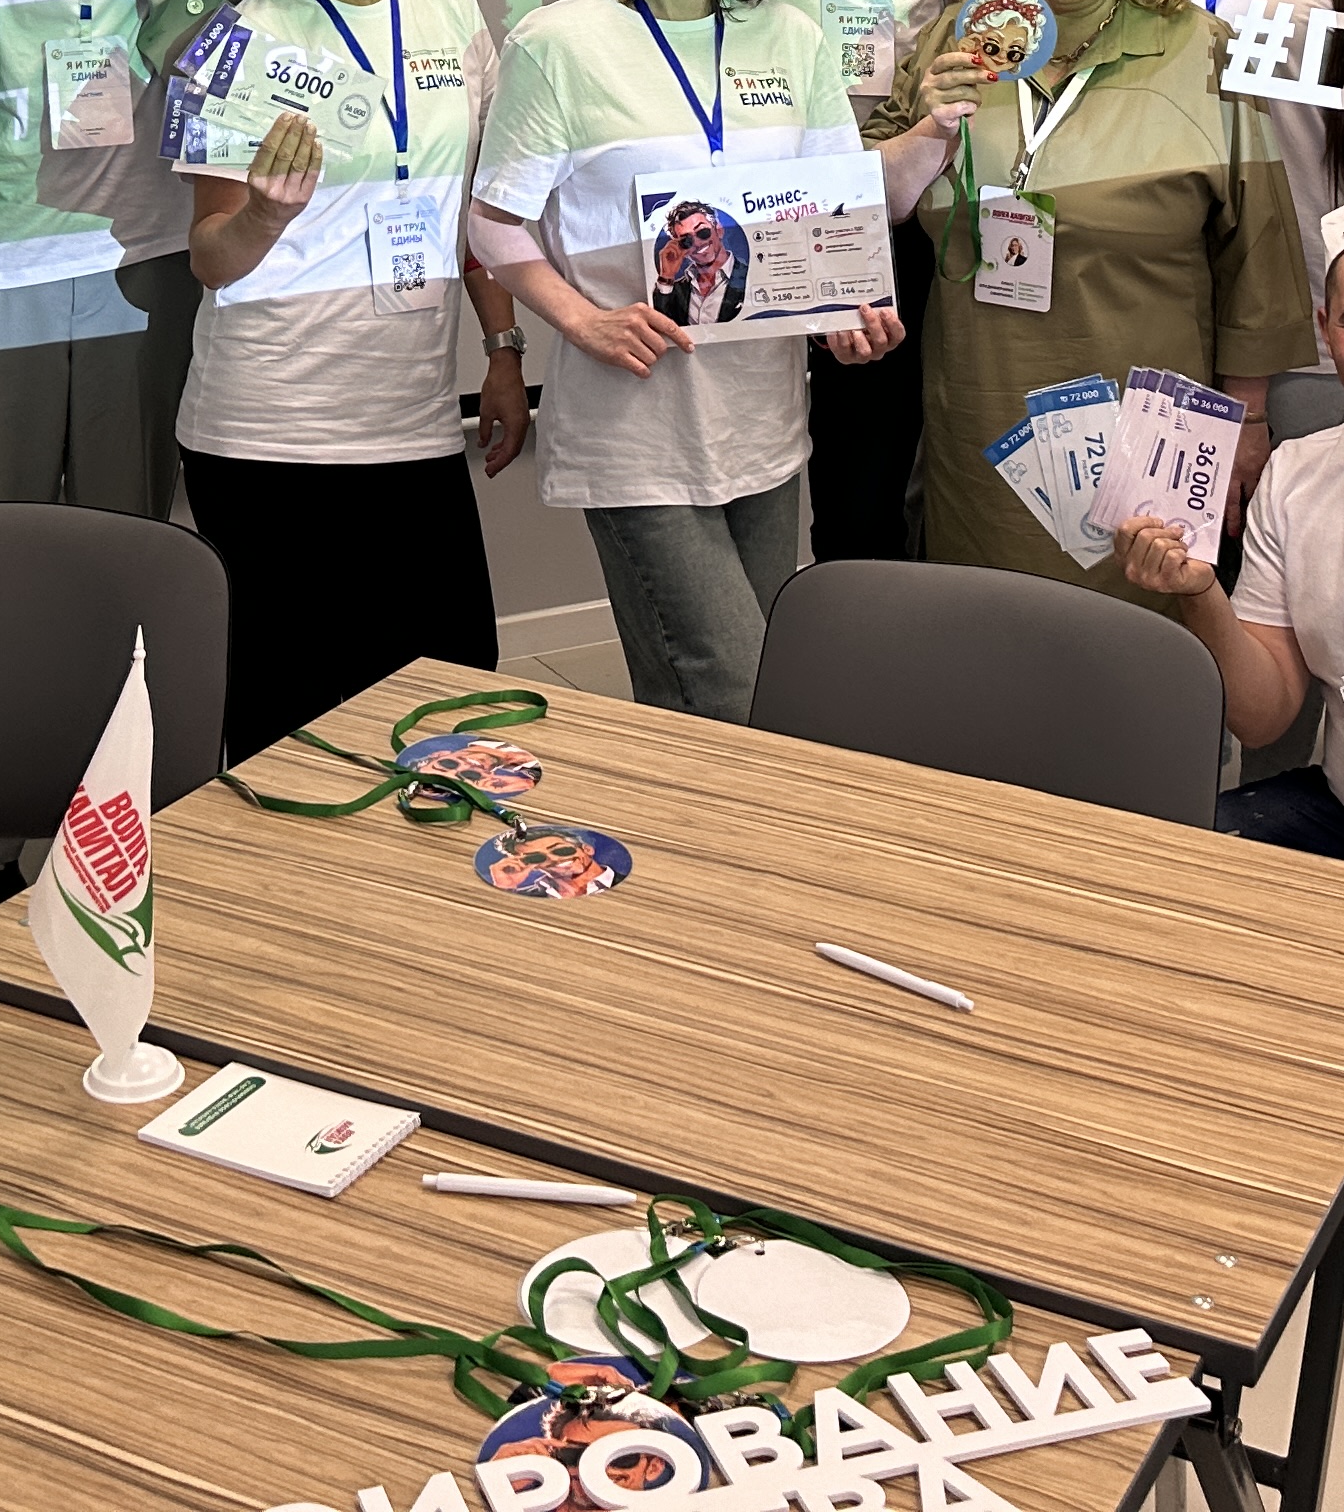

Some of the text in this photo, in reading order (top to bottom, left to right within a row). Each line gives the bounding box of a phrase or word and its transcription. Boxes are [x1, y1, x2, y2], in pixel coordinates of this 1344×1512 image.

[838, 16, 879, 26] Я И ТРУД
[200, 37, 213, 51] 36
[209, 22, 225, 40] 000
[842, 25, 875, 37] ЕДИНЫ
[66, 58, 112, 70] Я И ТРУД
[221, 58, 234, 73] 36
[228, 41, 242, 60] 000
[409, 57, 461, 73] Я И ТРУД
[71, 70, 108, 82] ЕДИНЫ
[265, 60, 293, 85] 36
[294, 71, 335, 100] 000
[414, 73, 466, 92] ЕДИНЫ
[733, 75, 791, 92] Я И ТРУД
[739, 92, 794, 108] ЕДИНЫ
[171, 115, 181, 132] 36
[742, 188, 810, 215] Бизнес-
[775, 201, 819, 223] акула
[387, 222, 427, 235] Я И ТРУД
[391, 233, 424, 247] ЕДИНЫ
[1069, 392, 1082, 402] 72
[1082, 389, 1100, 400] 000
[1200, 400, 1212, 411] 36
[1212, 402, 1229, 415] 000
[1009, 432, 1022, 446] 72
[1019, 421, 1034, 437] 000
[1084, 432, 1107, 460] 72
[1194, 440, 1218, 469] 36
[1186, 470, 1212, 512] 000
[67, 784, 140, 904] АПИТАЛ
